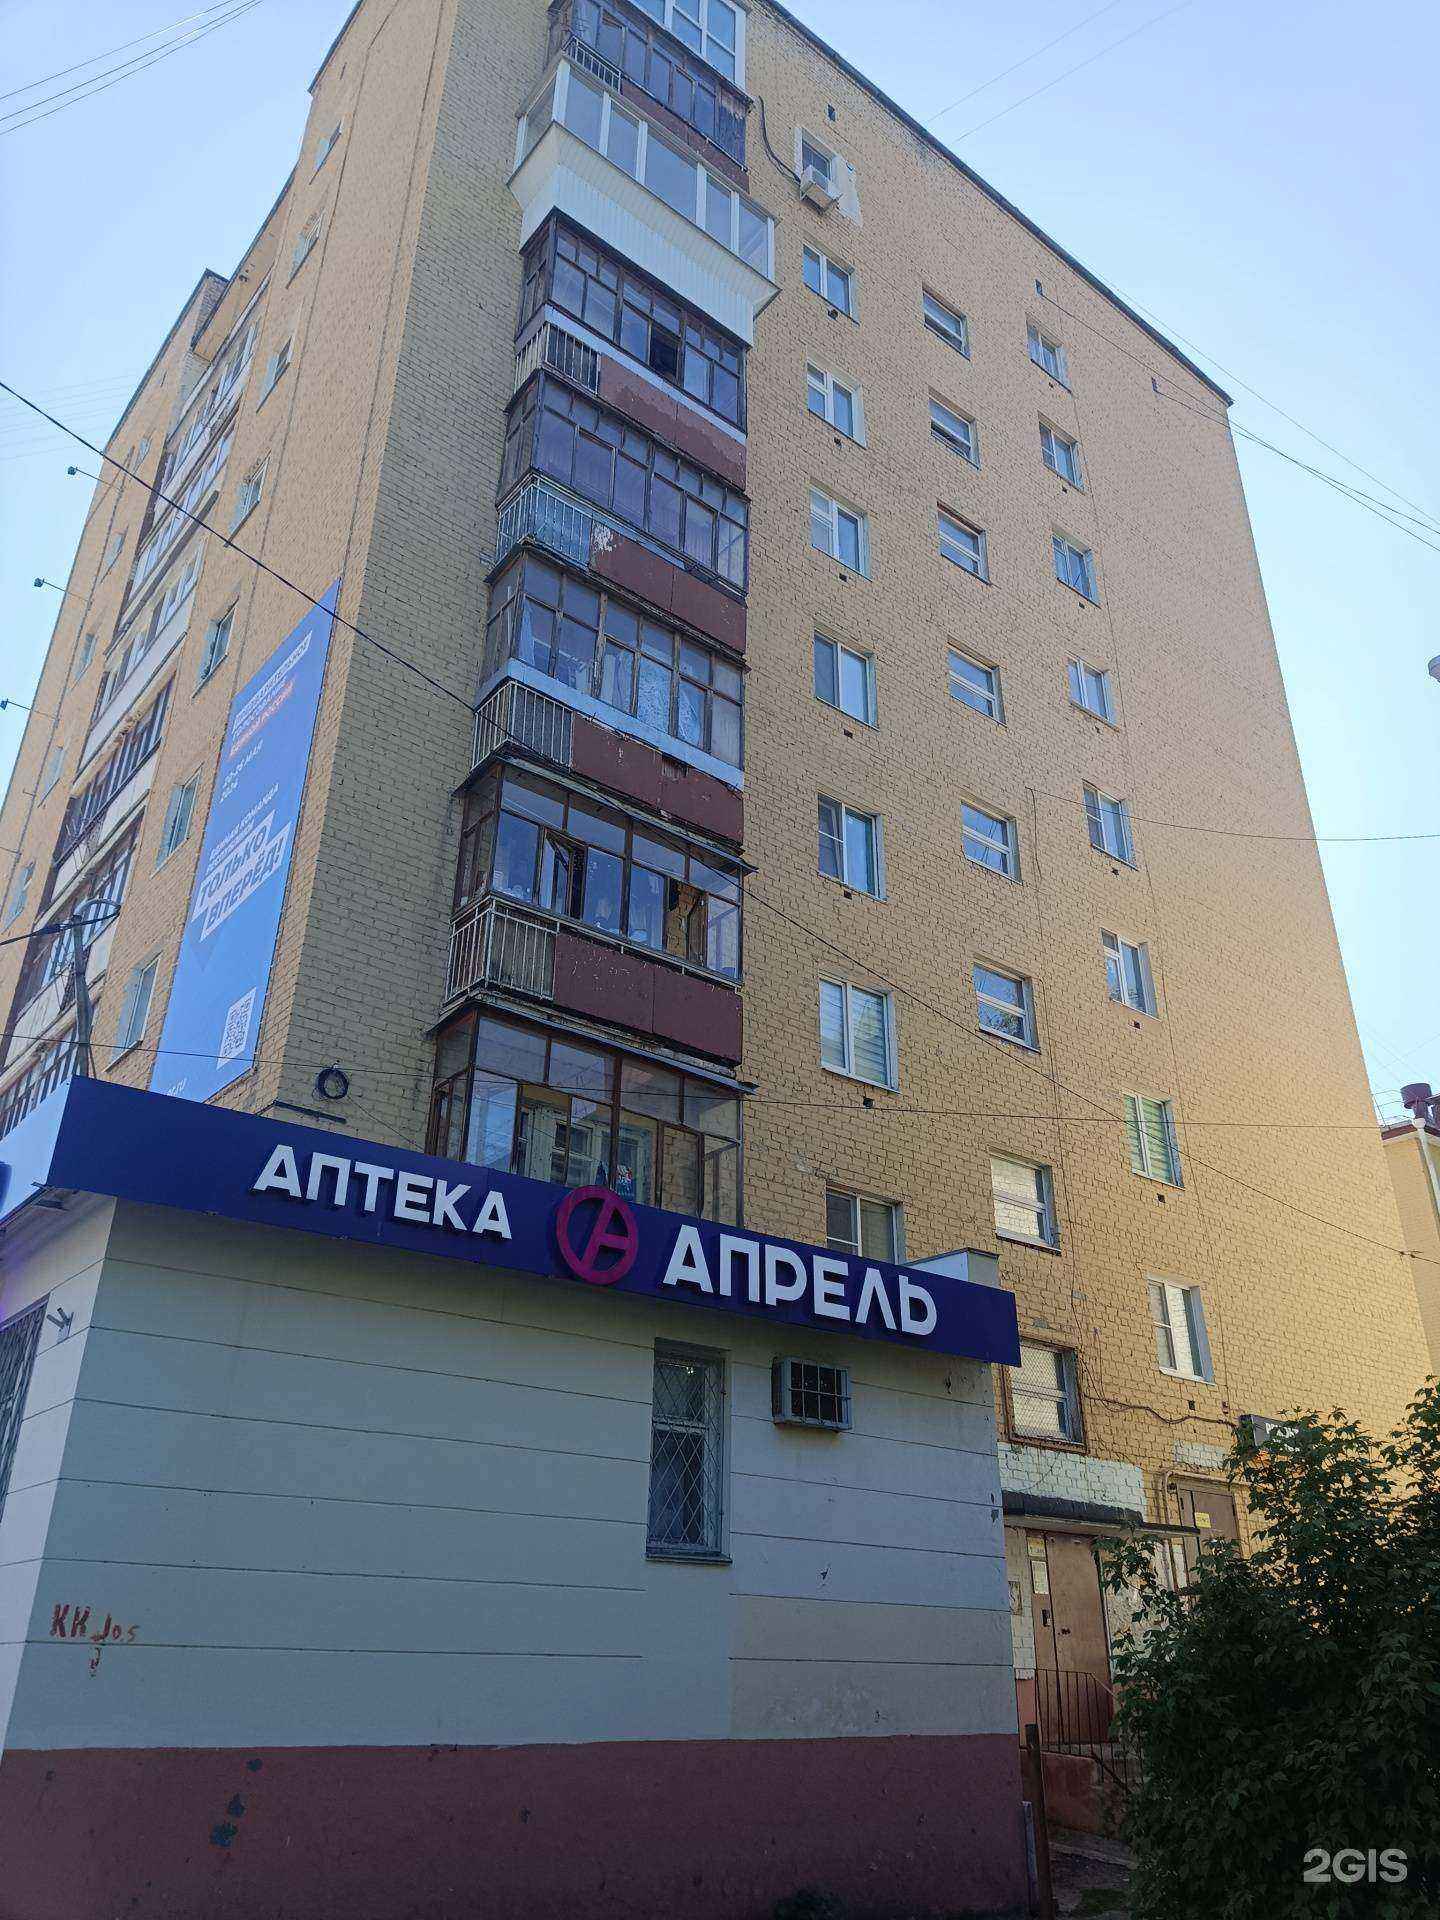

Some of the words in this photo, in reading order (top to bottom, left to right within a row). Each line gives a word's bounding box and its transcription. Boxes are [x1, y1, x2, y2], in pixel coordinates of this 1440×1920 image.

[199, 824, 267, 907] ТОЛЬКО
[252, 1143, 513, 1240] АПТЕКА
[661, 1223, 939, 1337] АПРЕЛЬ
